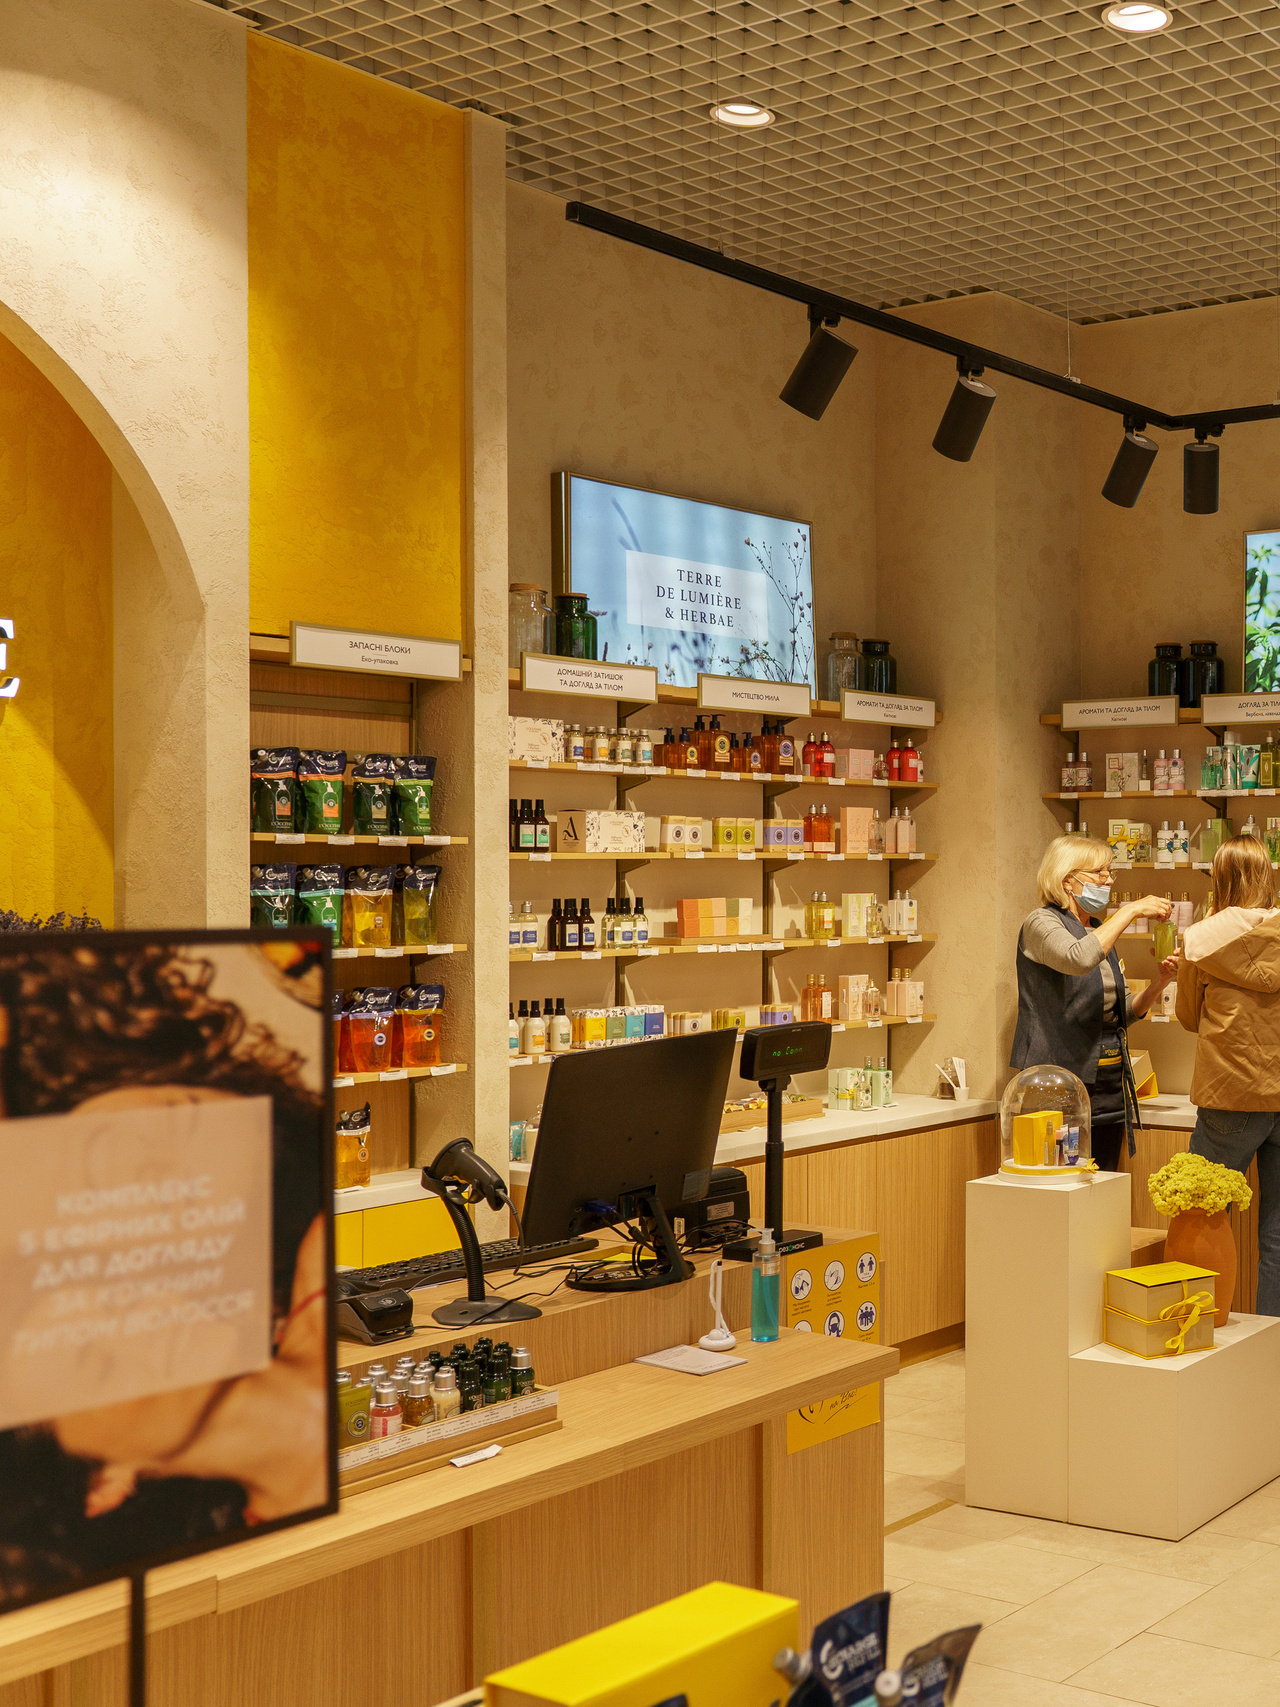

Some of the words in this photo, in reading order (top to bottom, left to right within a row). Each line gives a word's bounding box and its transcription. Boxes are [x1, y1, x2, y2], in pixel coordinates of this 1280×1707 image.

[676, 568, 722, 588] TERRE
[656, 585, 675, 600] DE
[680, 589, 742, 610] LUMIÈRE
[665, 606, 675, 619] &
[680, 608, 734, 628] HERBAE
[349, 640, 373, 651] ЗАПАСНІ
[384, 645, 411, 654] БЛОКИ
[361, 655, 399, 665] Еко-упаковка
[557, 668, 593, 678] ДОМАШНІЙ
[593, 672, 624, 681] ЗАТИШОК
[569, 681, 594, 689] ДОГЛЯД
[604, 683, 624, 691] ТІЛОМ
[732, 691, 764, 701] МИСТЕЦТВО
[764, 694, 780, 702] МИЛА
[856, 700, 879, 708] АРОМАТИ
[885, 703, 903, 711] ДОГЛЯД
[1112, 706, 1135, 714] ДОГЛЯД
[1238, 701, 1261, 709] ДОГЛЯД
[56, 1176, 212, 1216] КОМПЛЕКС
[32, 1254, 98, 1290] ДЛЯ
[104, 1233, 235, 1278] ДОГЛЯДУ
